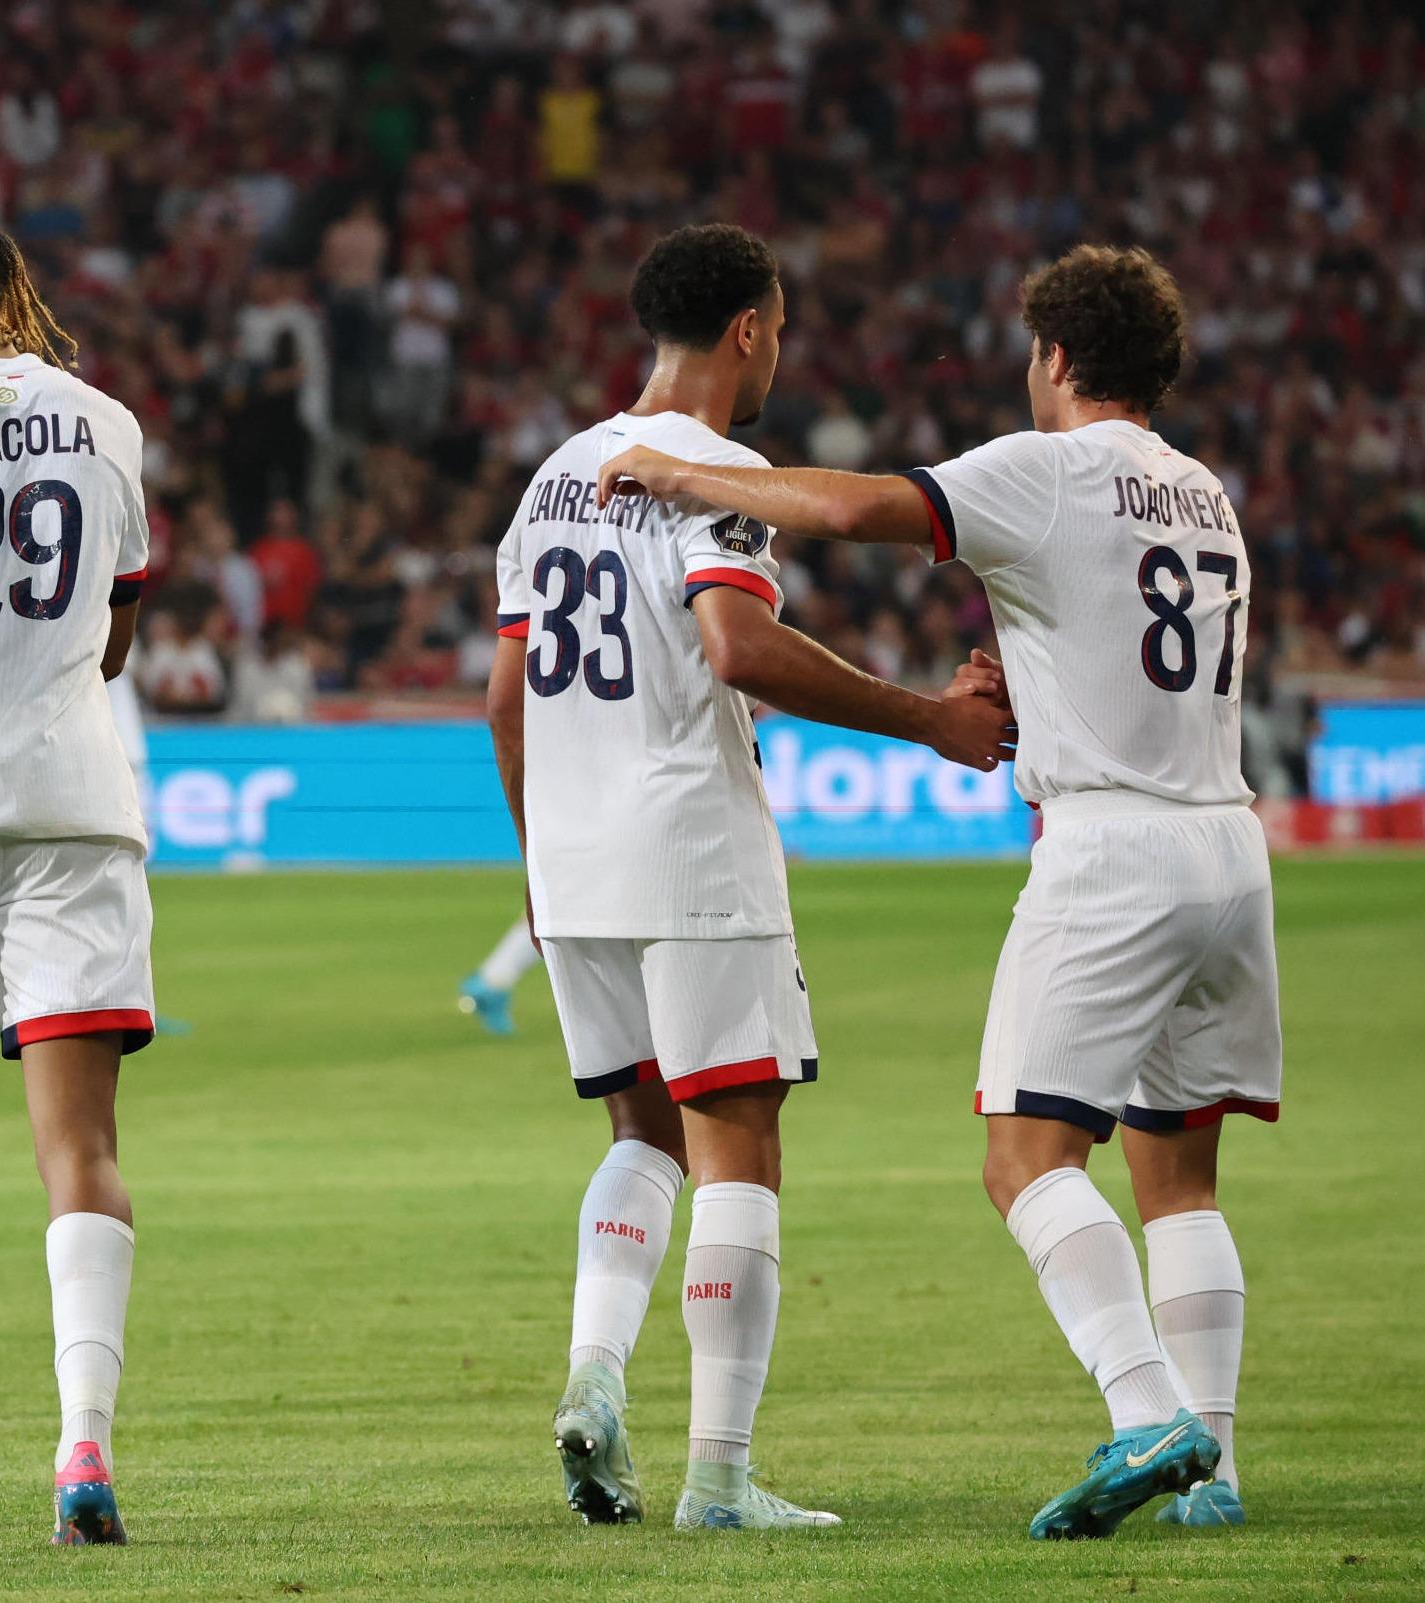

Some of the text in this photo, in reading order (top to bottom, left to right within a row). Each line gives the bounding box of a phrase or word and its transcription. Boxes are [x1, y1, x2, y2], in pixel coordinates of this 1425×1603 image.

[1113, 473, 1173, 527] JOÃO
[725, 529, 748, 542] LIGUE
[527, 546, 635, 701] 33
[1138, 545, 1242, 696] 87
[595, 1221, 646, 1245] PARIS
[687, 1282, 733, 1302] PARIS
